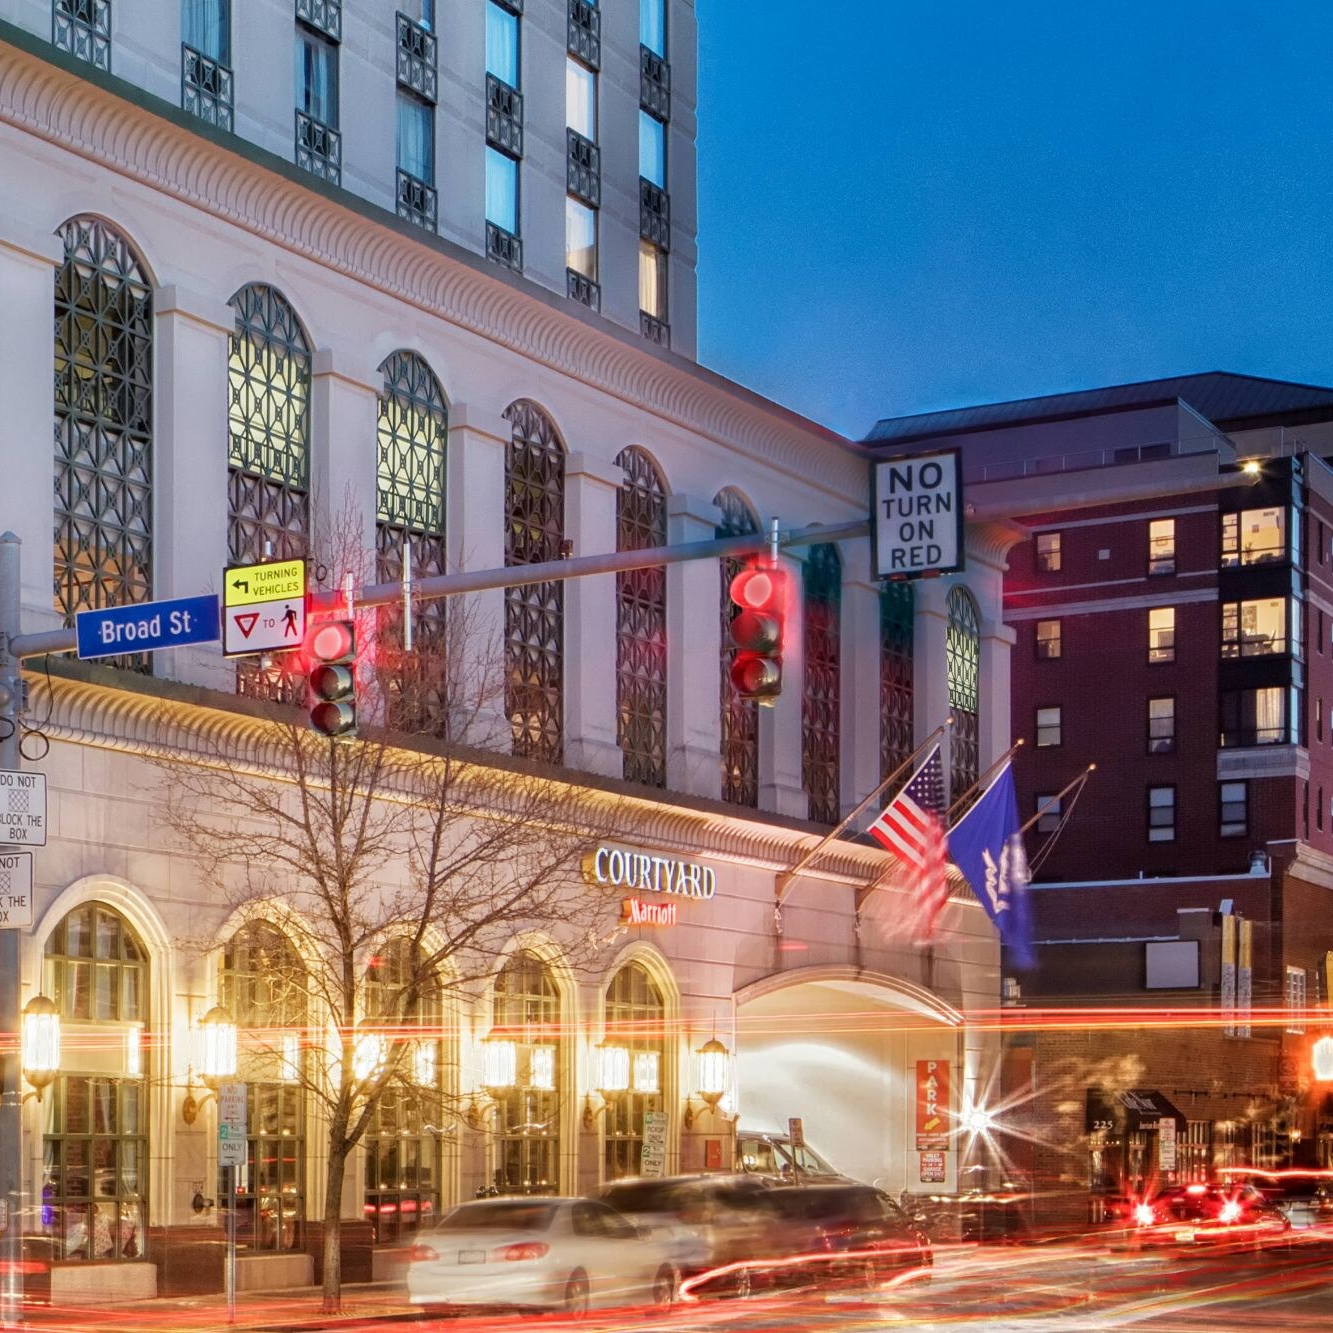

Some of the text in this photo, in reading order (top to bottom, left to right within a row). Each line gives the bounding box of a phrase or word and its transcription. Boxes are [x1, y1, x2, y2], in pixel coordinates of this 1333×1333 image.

[889, 462, 942, 494] NO
[882, 492, 951, 519] TURN
[899, 519, 934, 542] ON
[891, 544, 942, 569] RED
[254, 567, 298, 581] TURNING
[253, 581, 299, 596] VEHICLES
[101, 610, 191, 644] Broad St
[263, 618, 275, 628] TO
[0, 774, 36, 788] DO NOT
[27, 815, 42, 827] THE
[9, 828, 27, 840] BOX
[595, 847, 716, 899] COURTYARD
[8, 895, 26, 908] THE
[628, 899, 677, 926] Marriott
[227, 1086, 237, 1094] NO
[926, 1061, 938, 1115] PARK
[1093, 1120, 1113, 1129] 225
[222, 1143, 242, 1151] ONLY
